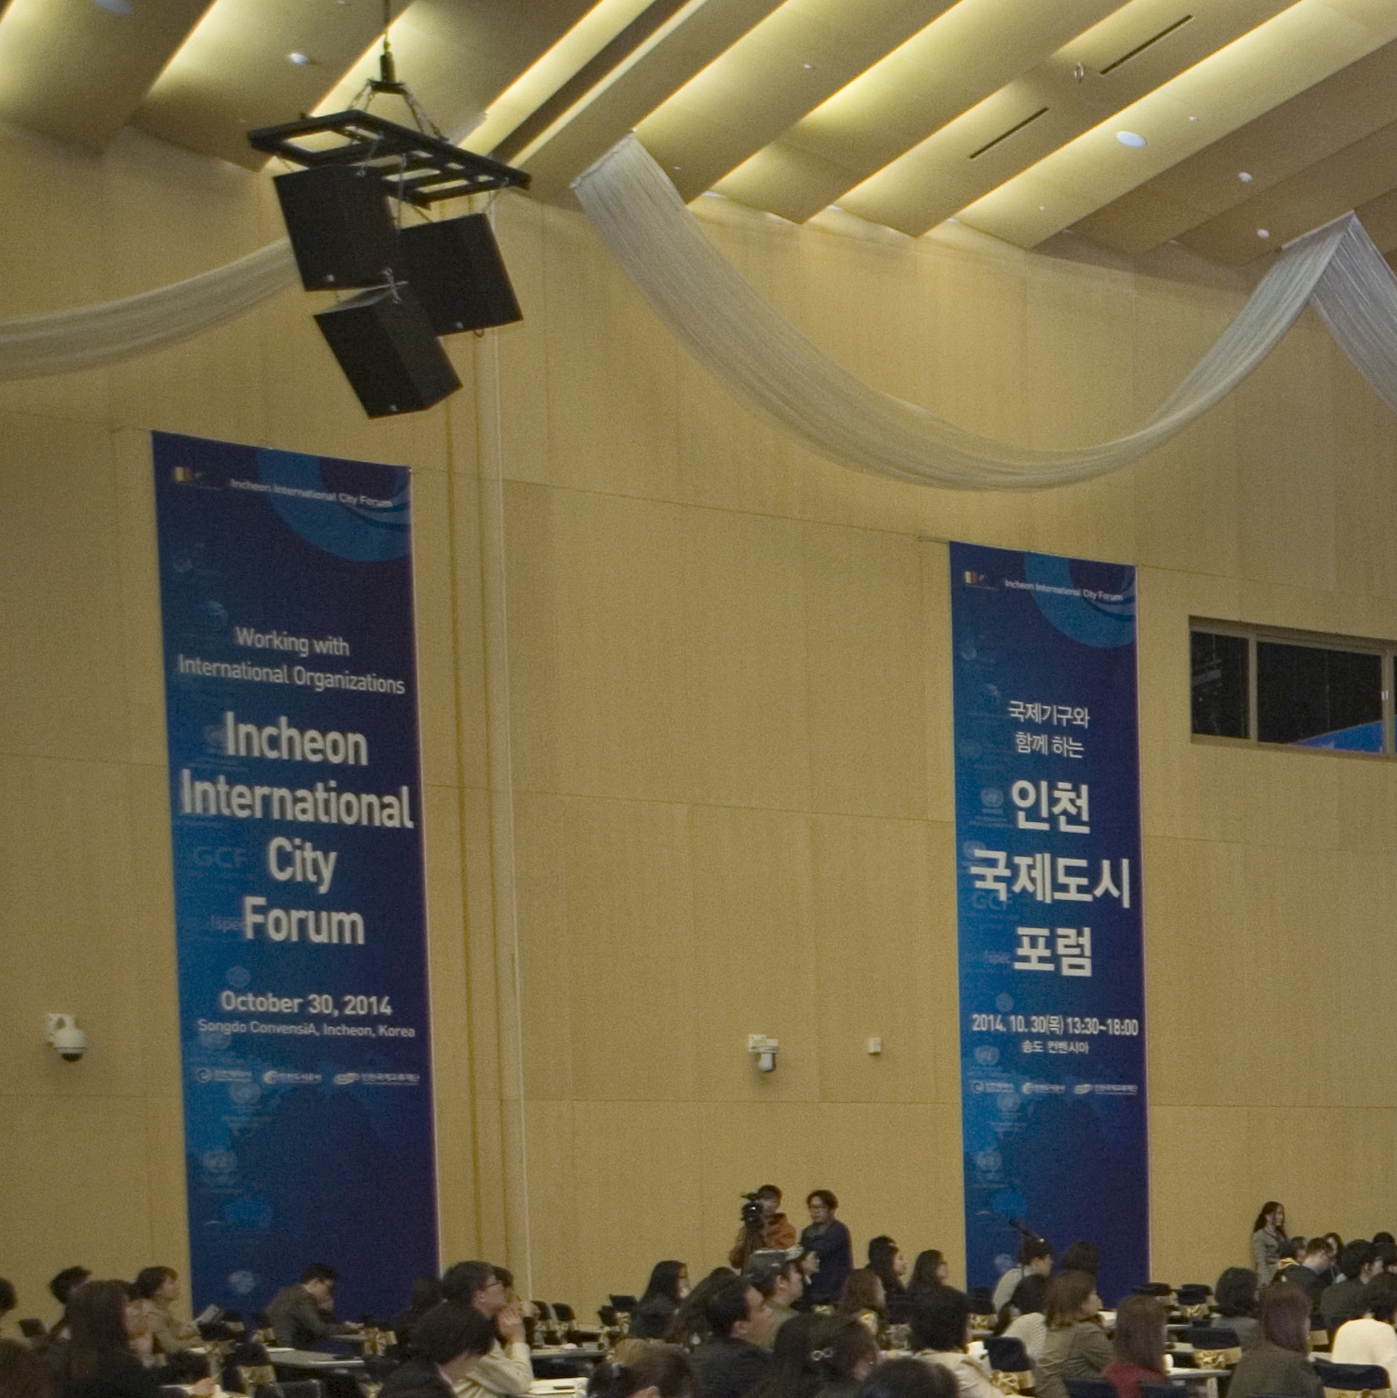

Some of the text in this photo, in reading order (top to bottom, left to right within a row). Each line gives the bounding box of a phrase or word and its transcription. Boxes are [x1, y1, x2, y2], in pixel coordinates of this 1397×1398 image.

[231, 478, 393, 509] Incheon International City Forum
[1005, 578, 1124, 602] Incheon International City Forum
[235, 626, 350, 657] Working with
[178, 653, 405, 695] International Organizations
[1008, 700, 1090, 728] 국제기구와
[225, 710, 368, 766] Incheon
[1015, 731, 1085, 759] 함께 하는
[180, 769, 414, 829] International
[1011, 779, 1091, 834] 인천
[267, 835, 337, 894] City
[969, 849, 1131, 908] 국제도시
[242, 896, 366, 945] Forum
[1013, 926, 1093, 977] 포럼
[221, 989, 393, 1017] October 30, 2014
[198, 1018, 416, 1039] Songdo ConvensiA, Incheon, Korea
[972, 1013, 1139, 1037] 2014. 10. 30(목) 13:30~18:00
[1022, 1040, 1090, 1055] 송도 컨벤시아
